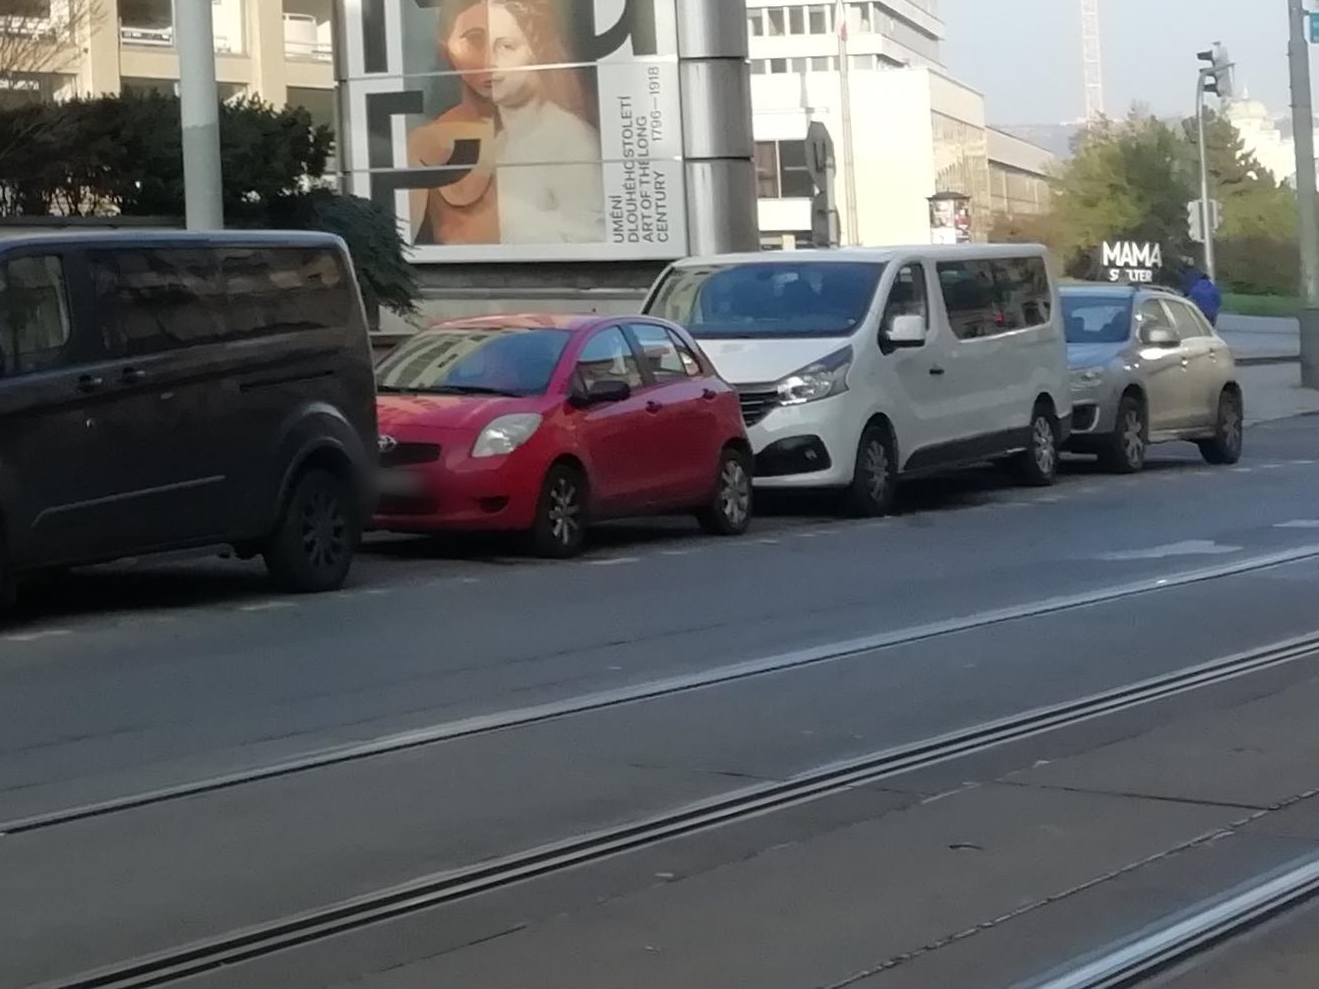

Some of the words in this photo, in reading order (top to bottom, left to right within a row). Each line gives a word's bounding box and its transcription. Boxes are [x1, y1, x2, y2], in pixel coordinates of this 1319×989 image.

[617, 96, 635, 158] STOLETÍ
[636, 115, 650, 158] LONG
[639, 160, 651, 187] THE
[640, 193, 653, 212] OF
[653, 170, 670, 243] CENTURY
[608, 195, 626, 244] UMĚNÍ
[640, 213, 655, 243] ART
[1102, 240, 1163, 267] MAMA
[1109, 268, 1153, 282] SLTER
